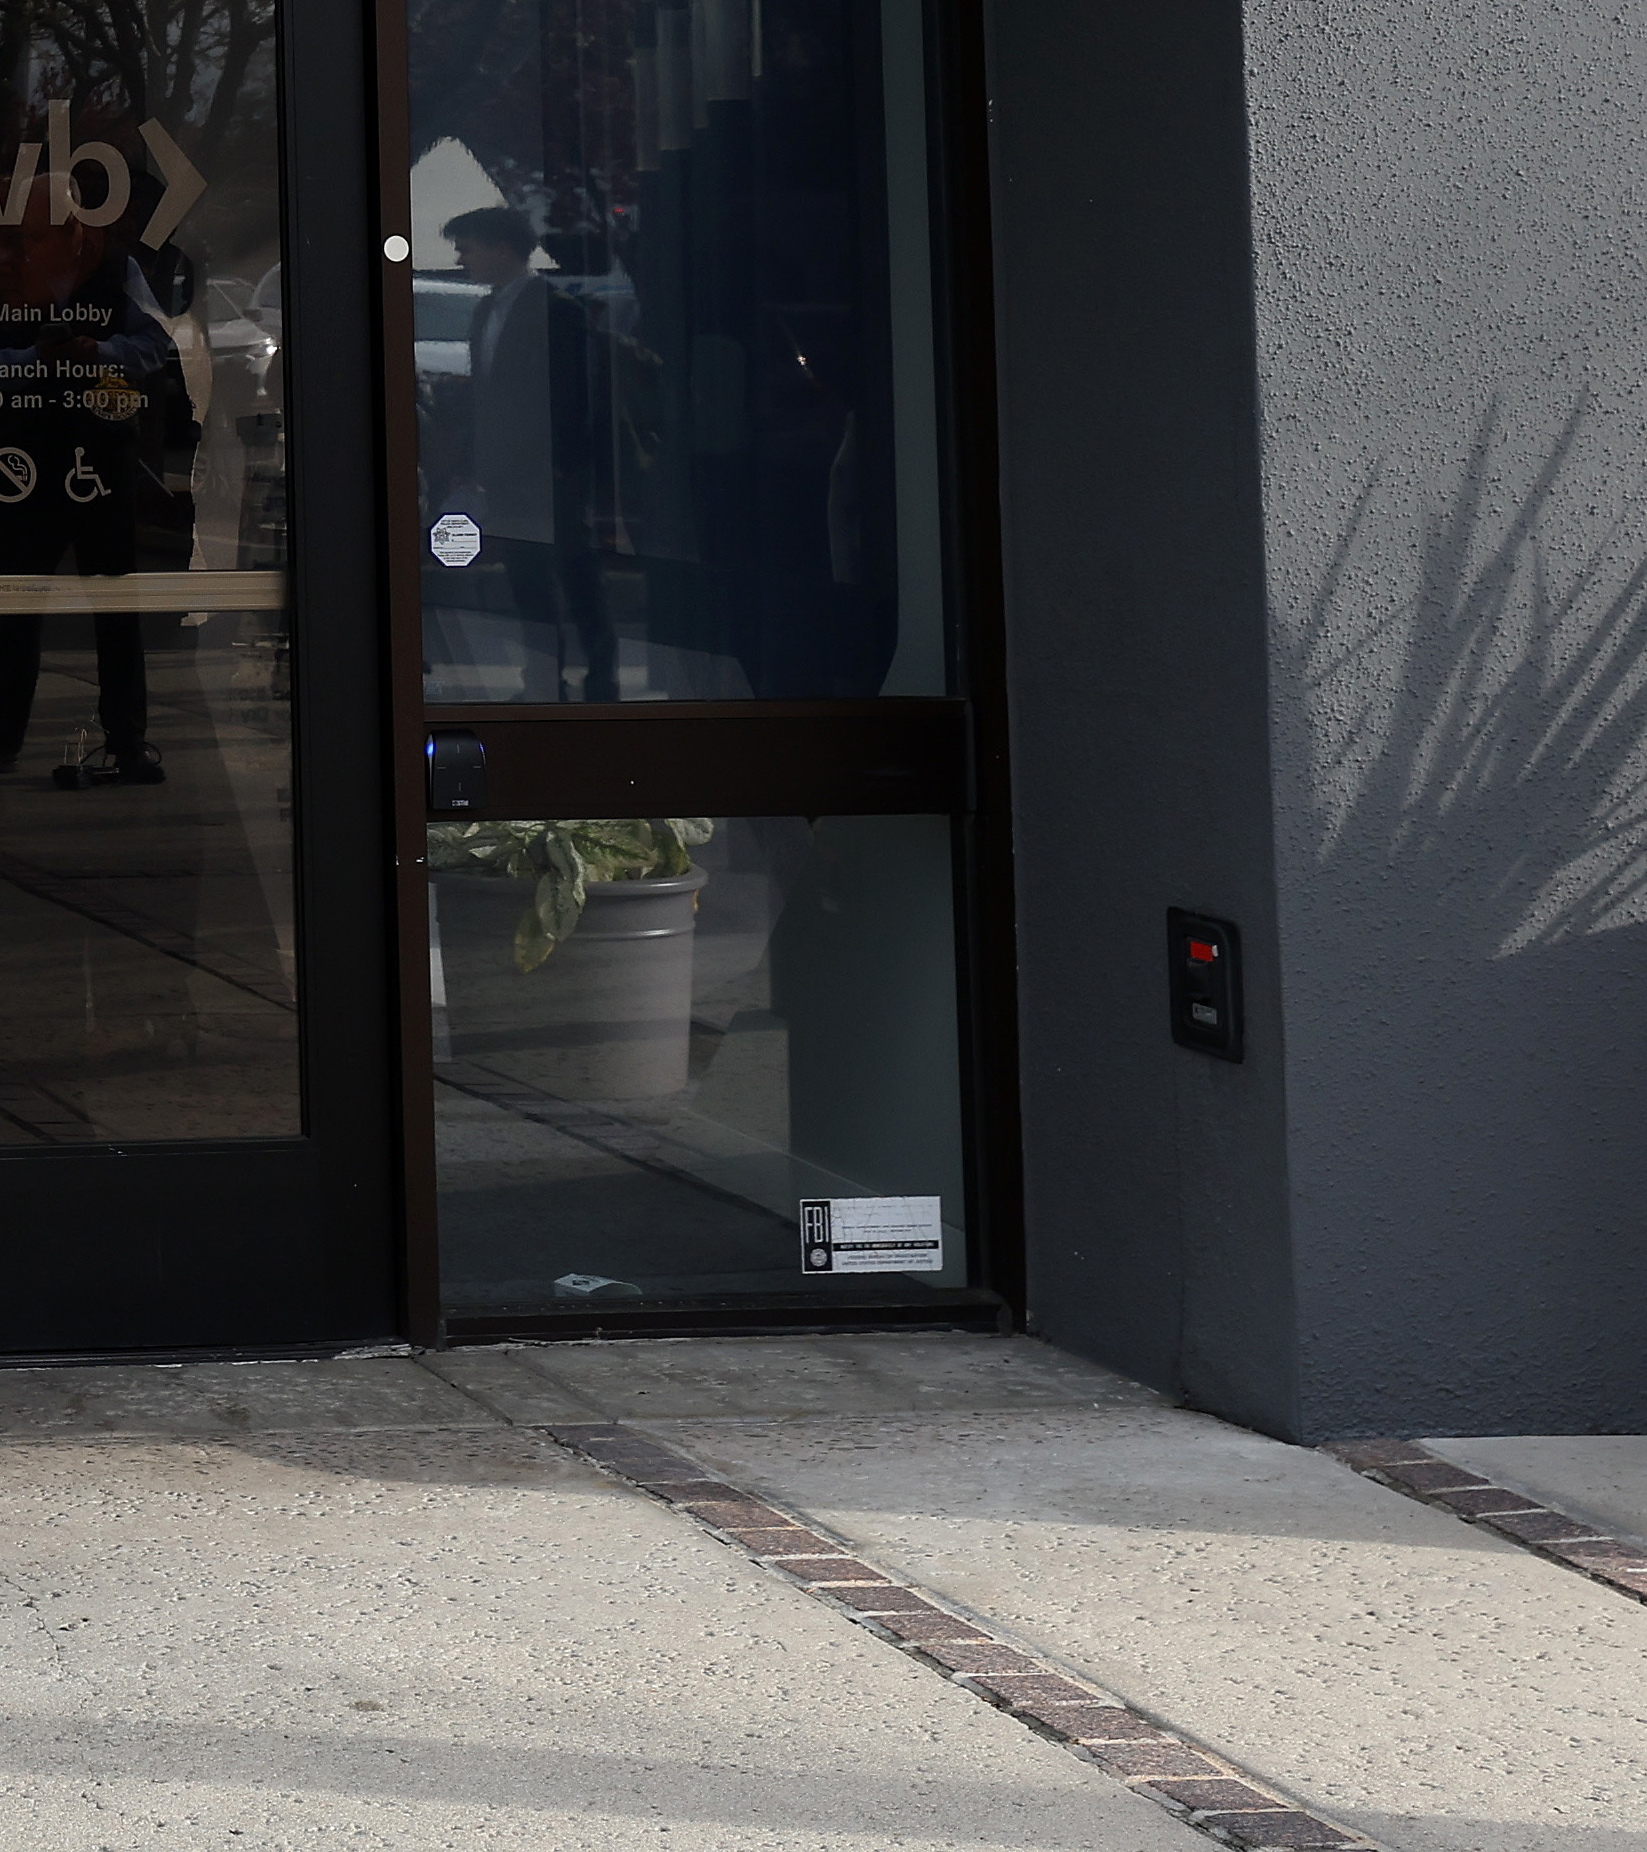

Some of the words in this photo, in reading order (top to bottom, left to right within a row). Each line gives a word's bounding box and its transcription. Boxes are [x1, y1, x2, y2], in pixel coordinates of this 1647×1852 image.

[49, 302, 113, 326] Lobby
[55, 359, 125, 379] Hours:
[10, 394, 43, 410] am
[62, 390, 110, 410] 3:00
[115, 394, 149, 414] pm
[803, 1206, 830, 1244] FBI
